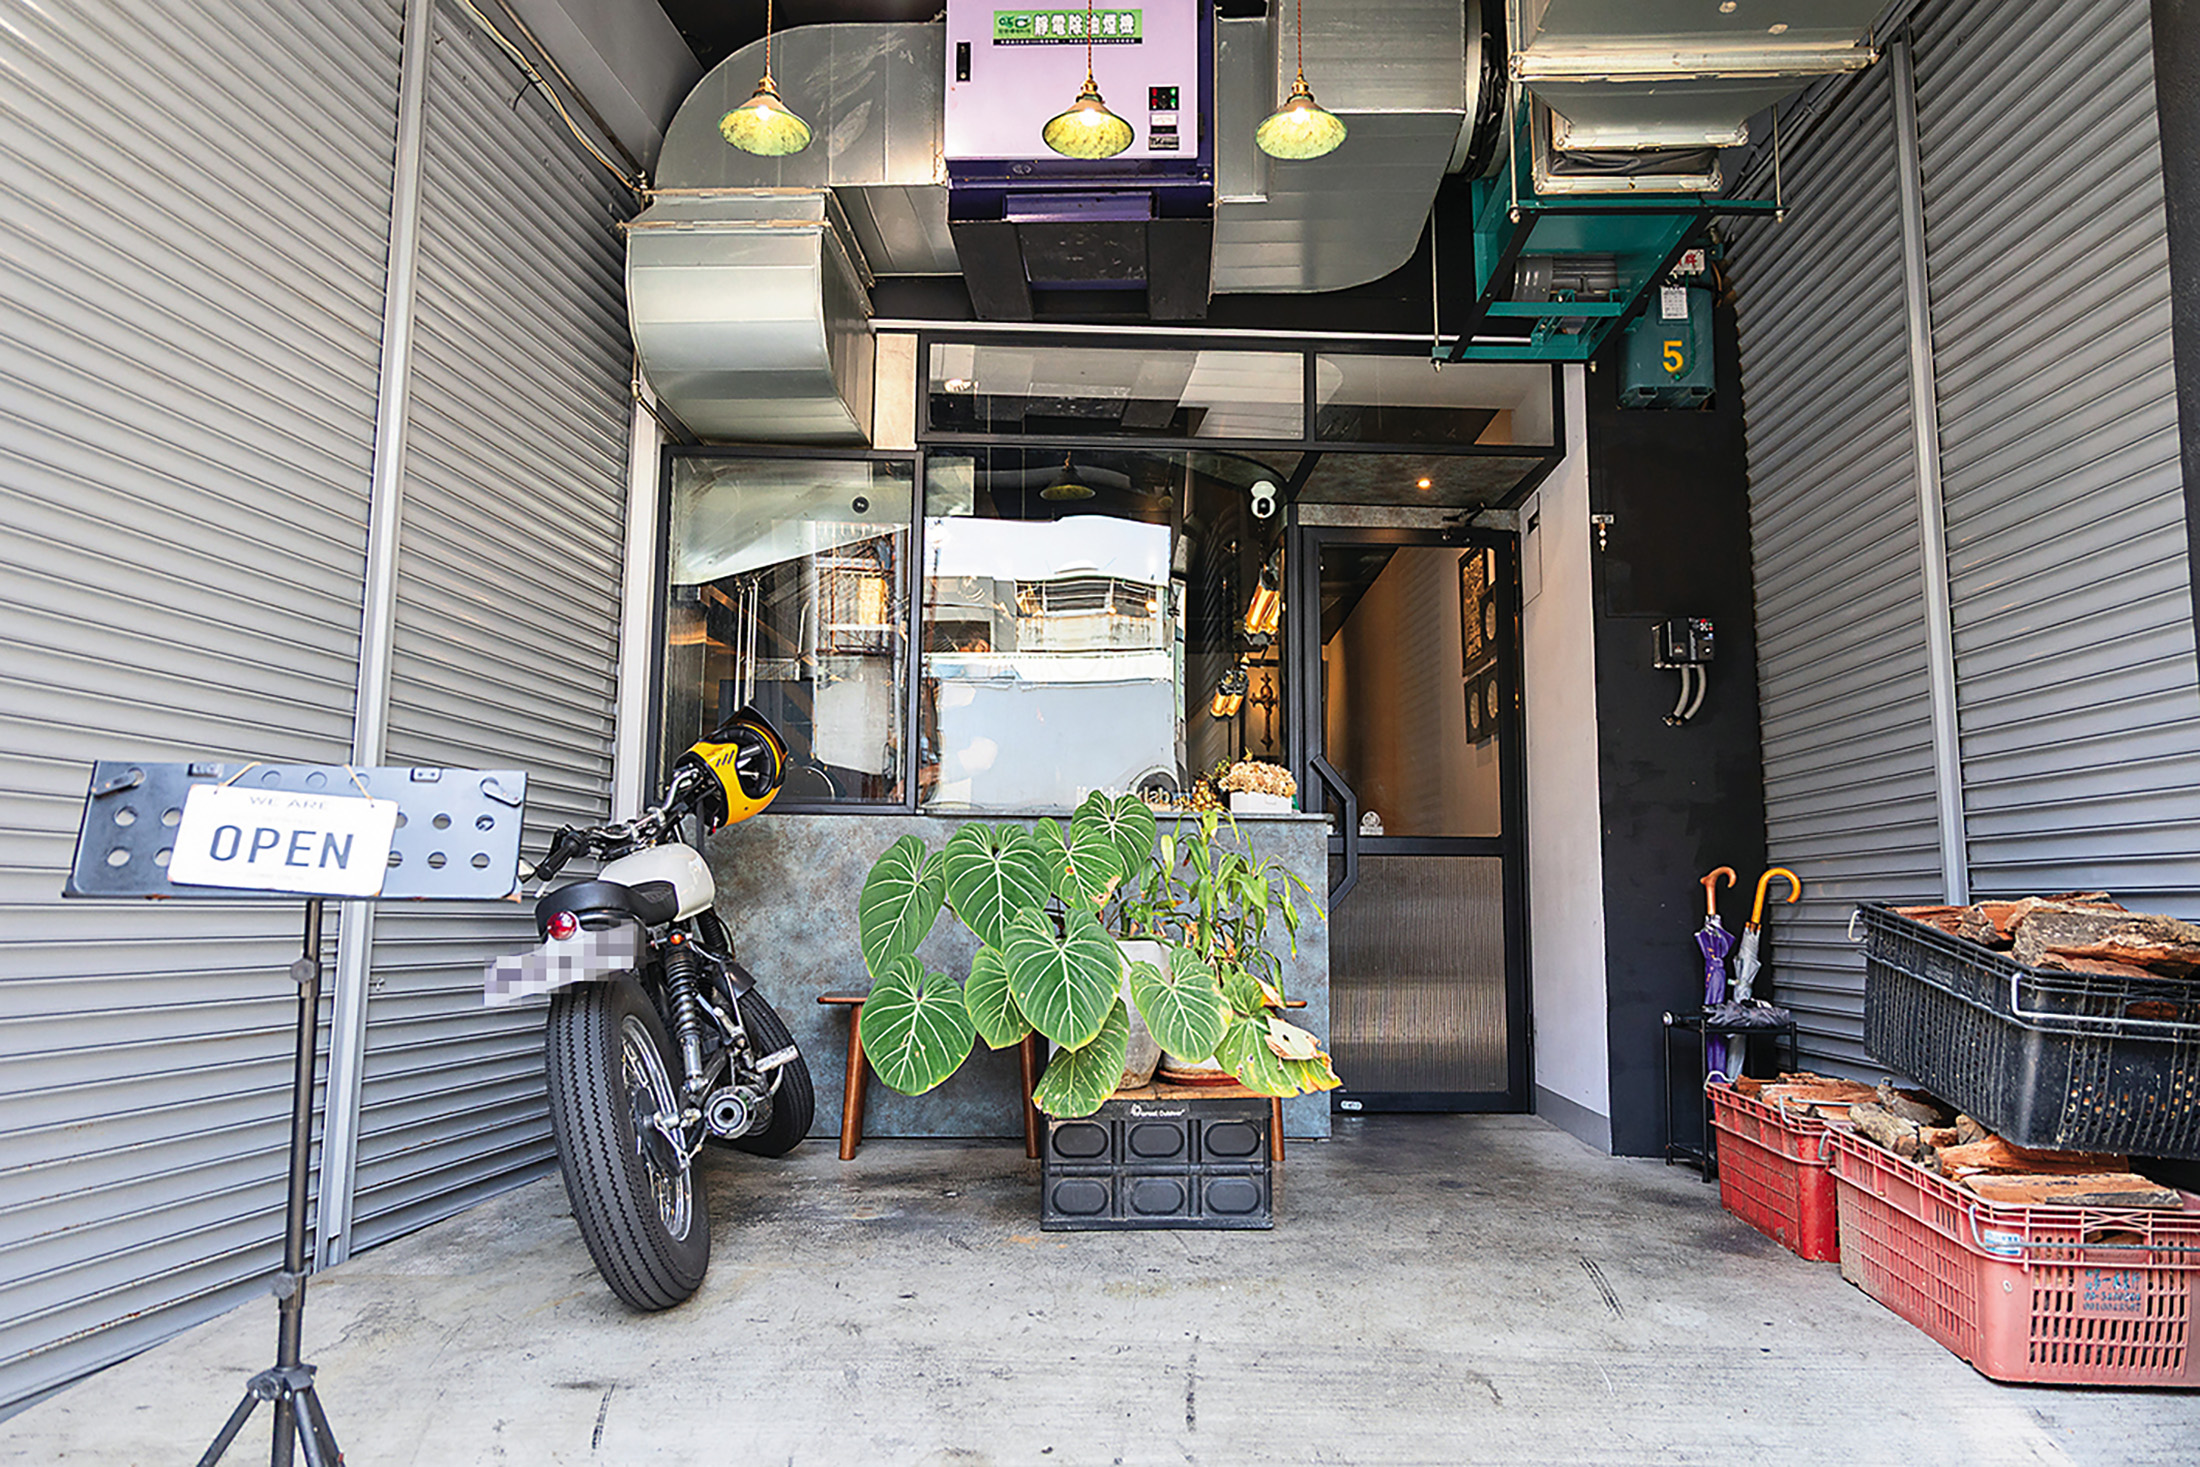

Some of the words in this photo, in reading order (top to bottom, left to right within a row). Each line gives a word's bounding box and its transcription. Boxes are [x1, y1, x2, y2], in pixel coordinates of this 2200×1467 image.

[1662, 340, 1684, 373] 5
[249, 795, 279, 806] WE
[287, 799, 330, 810] ARE
[208, 825, 354, 870] OPEN
